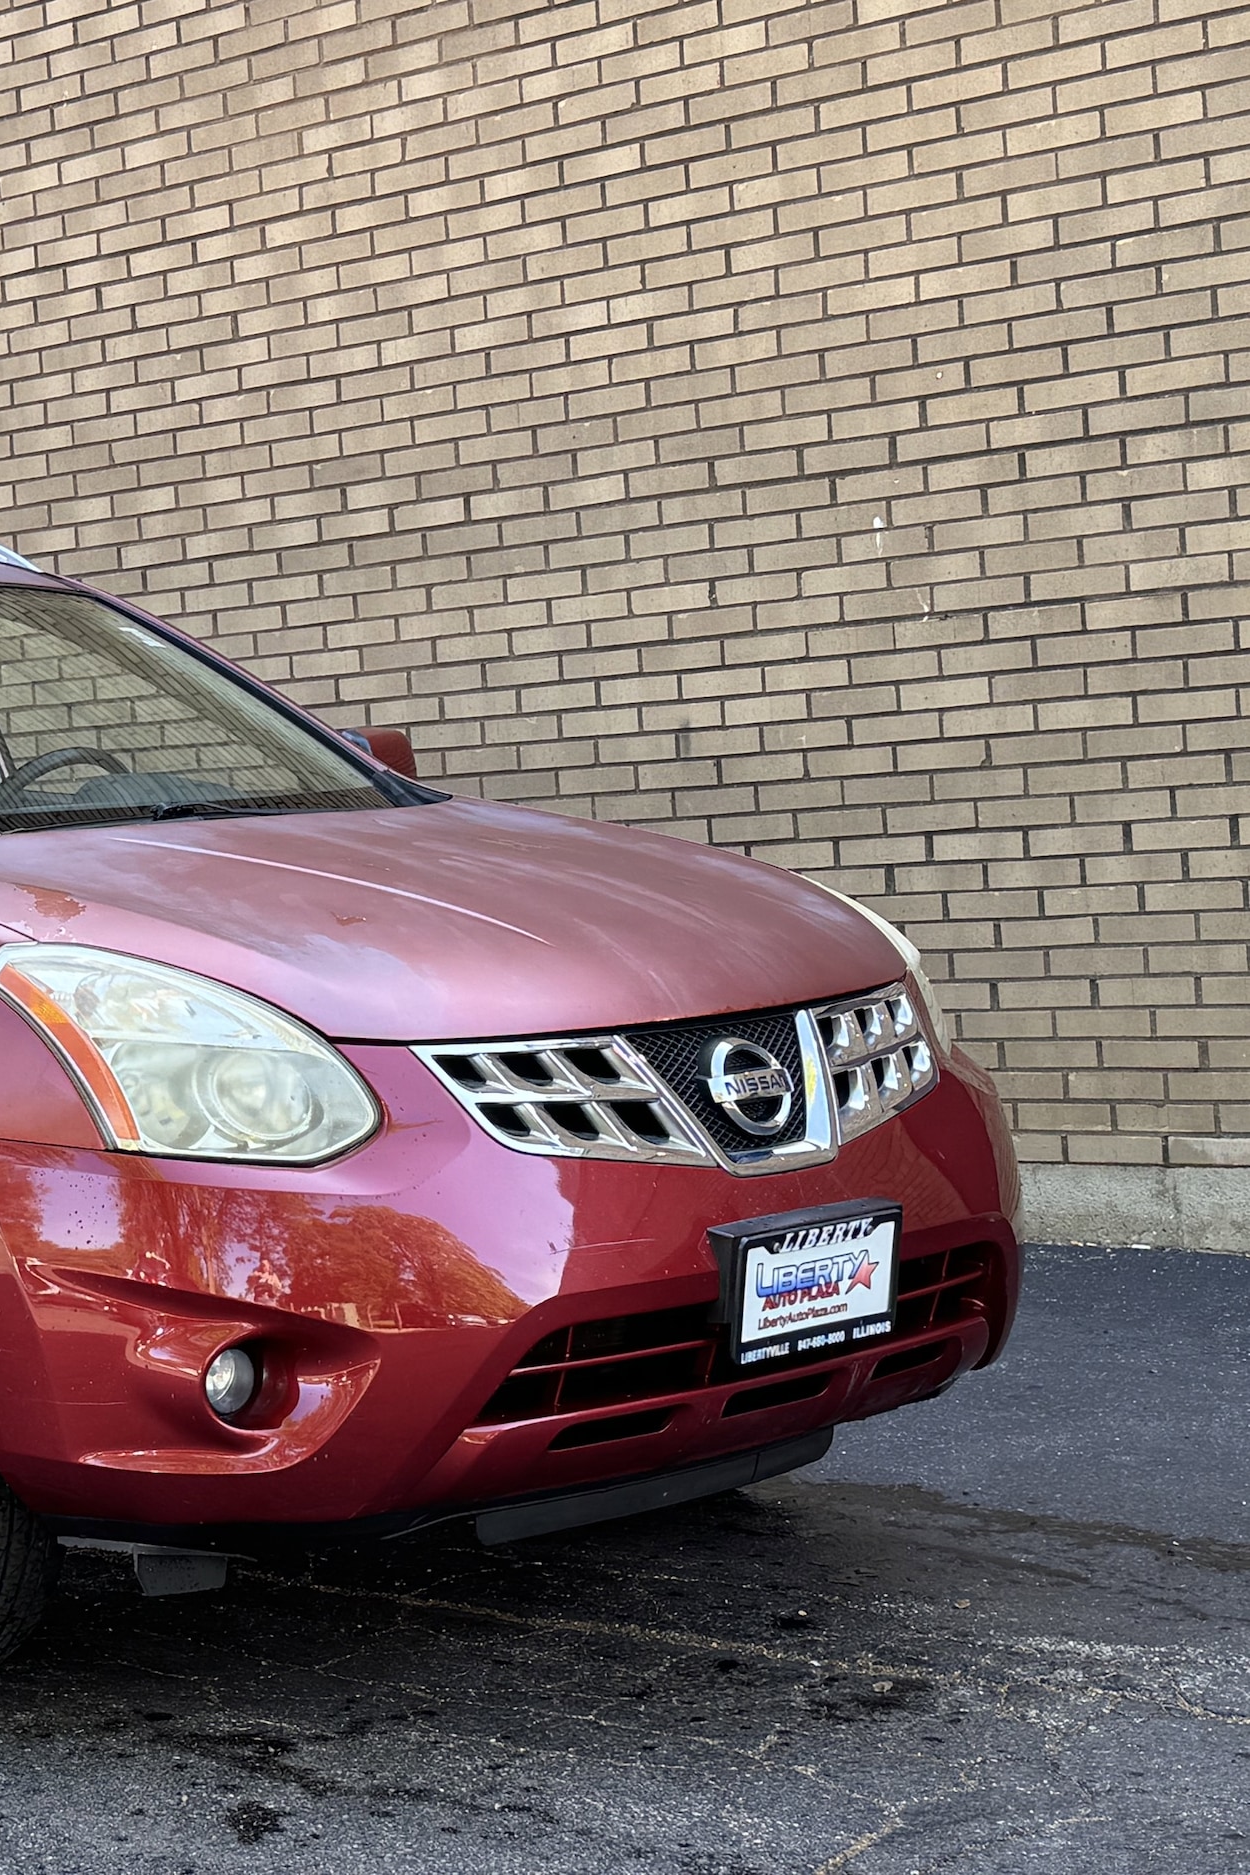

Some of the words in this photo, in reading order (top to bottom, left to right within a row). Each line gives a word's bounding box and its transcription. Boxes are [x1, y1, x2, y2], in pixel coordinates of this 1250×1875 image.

[724, 1072, 788, 1096] NISSAN
[778, 1217, 874, 1254] LIBERTY
[756, 1249, 869, 1298] LIBERTY
[762, 1291, 796, 1312] AUTO
[800, 1282, 840, 1304] PLAZA
[757, 1303, 848, 1331] LibertyAutoPlaza.com
[740, 1342, 790, 1365] LIBERTYVILLE
[852, 1320, 892, 1339] ILLINOIS
